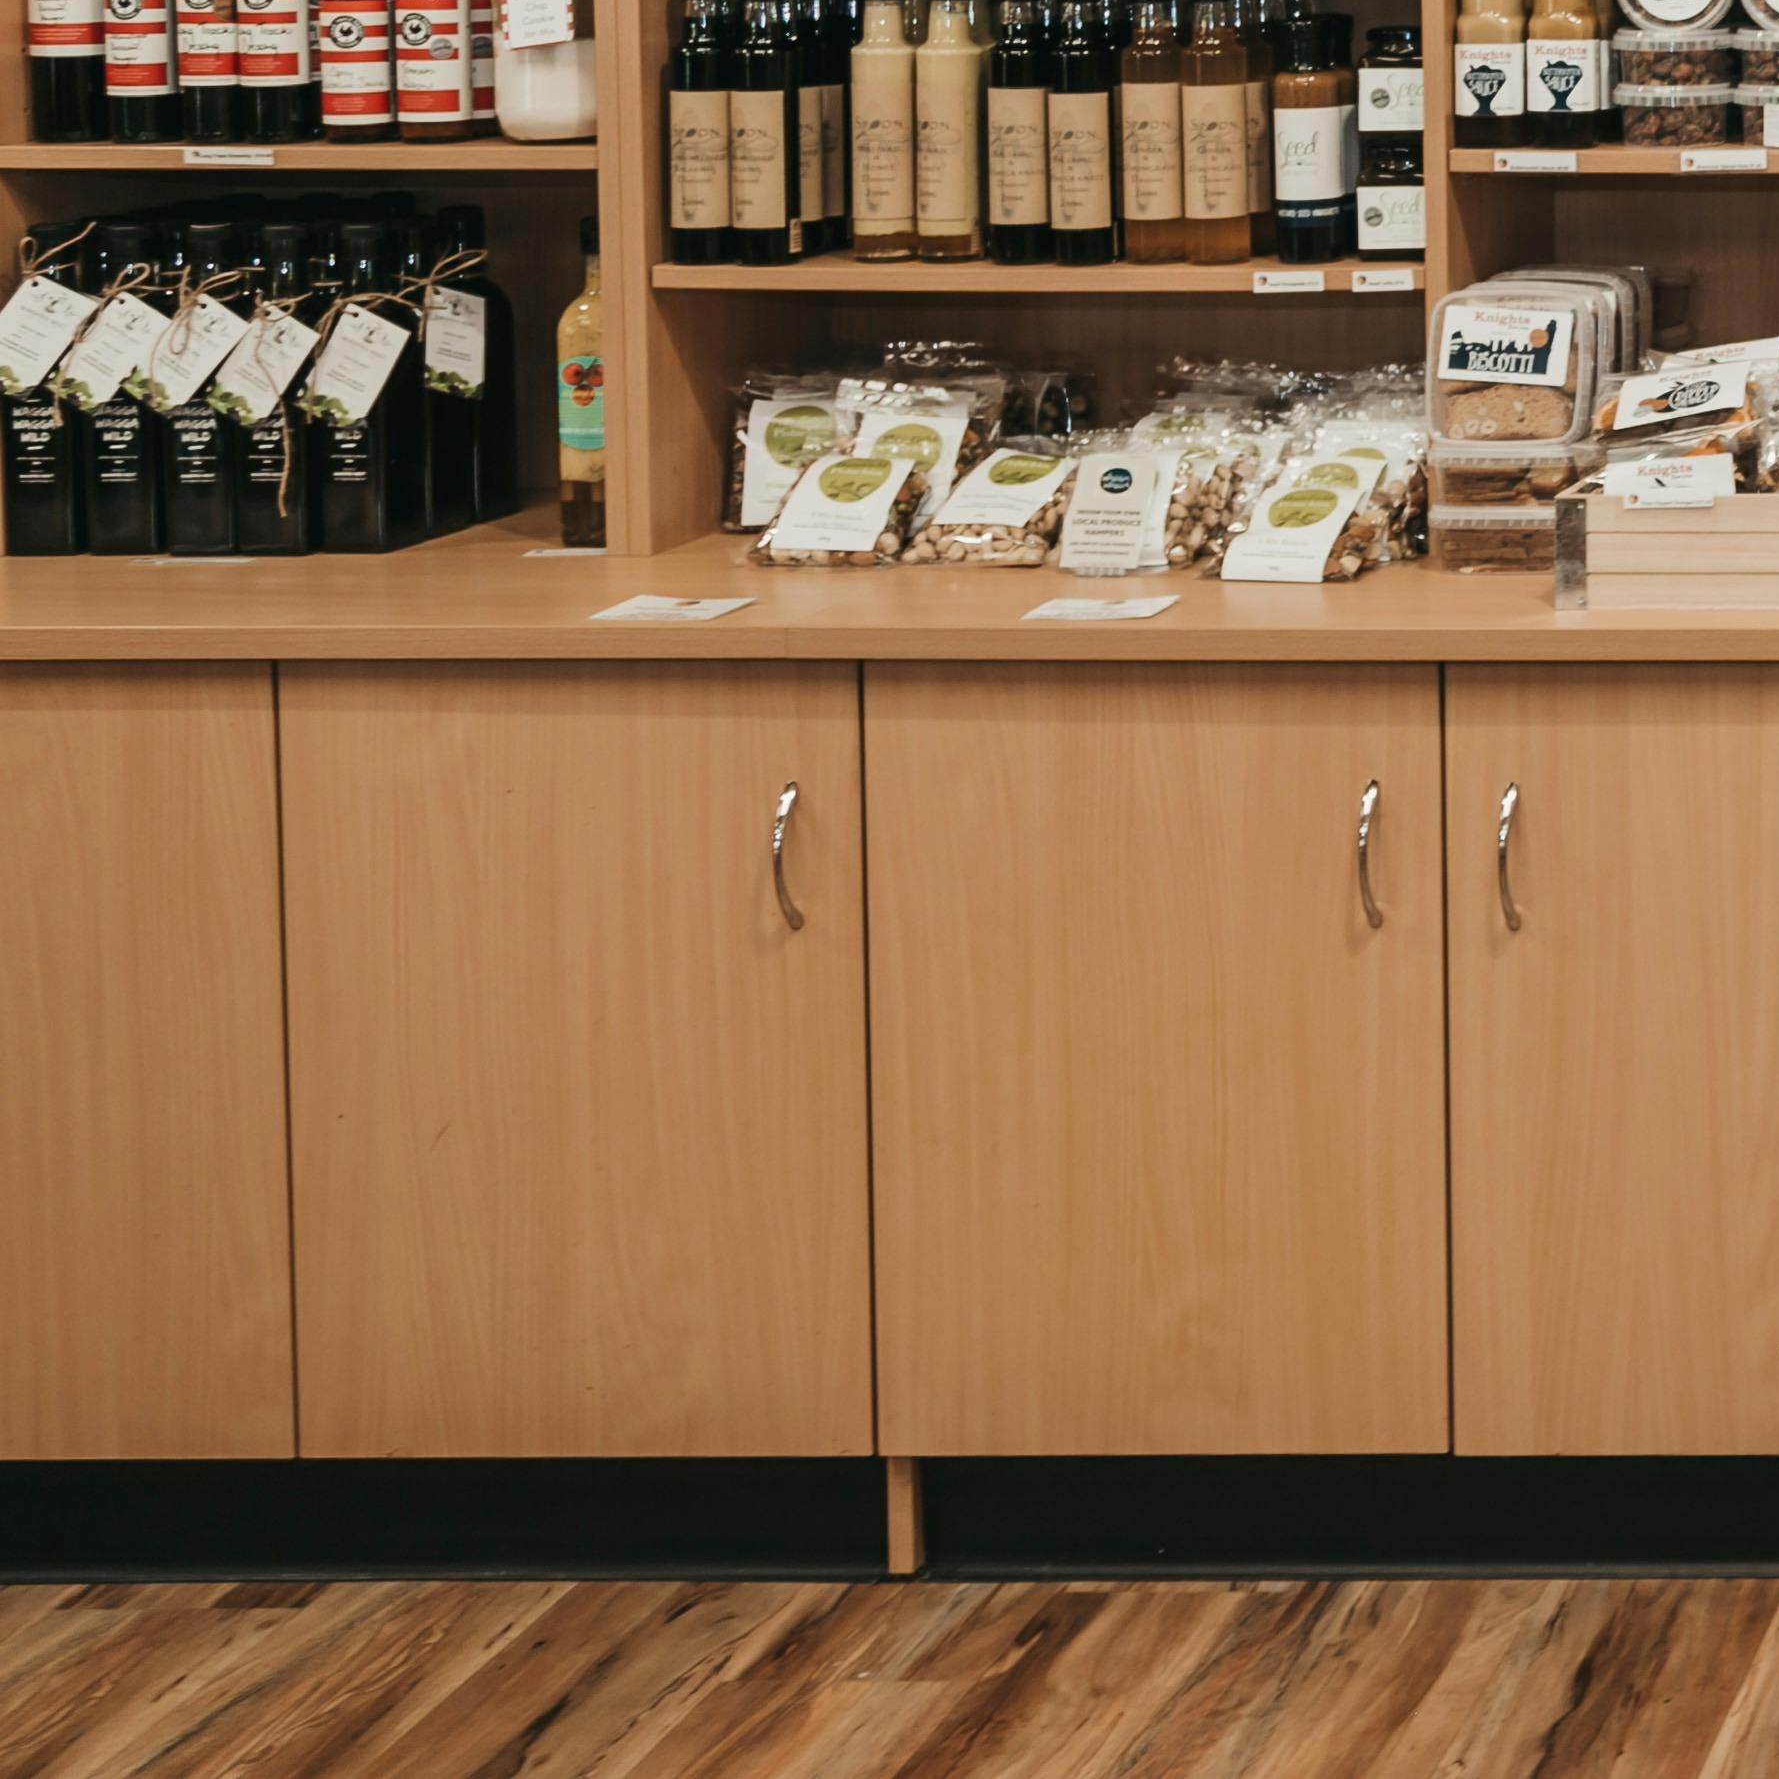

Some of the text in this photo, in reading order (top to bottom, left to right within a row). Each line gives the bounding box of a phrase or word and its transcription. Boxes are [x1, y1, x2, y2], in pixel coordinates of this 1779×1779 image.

[1278, 130, 1320, 170] Seed
[1474, 311, 1531, 326] Knights
[1467, 351, 1535, 374] BISCOTTI
